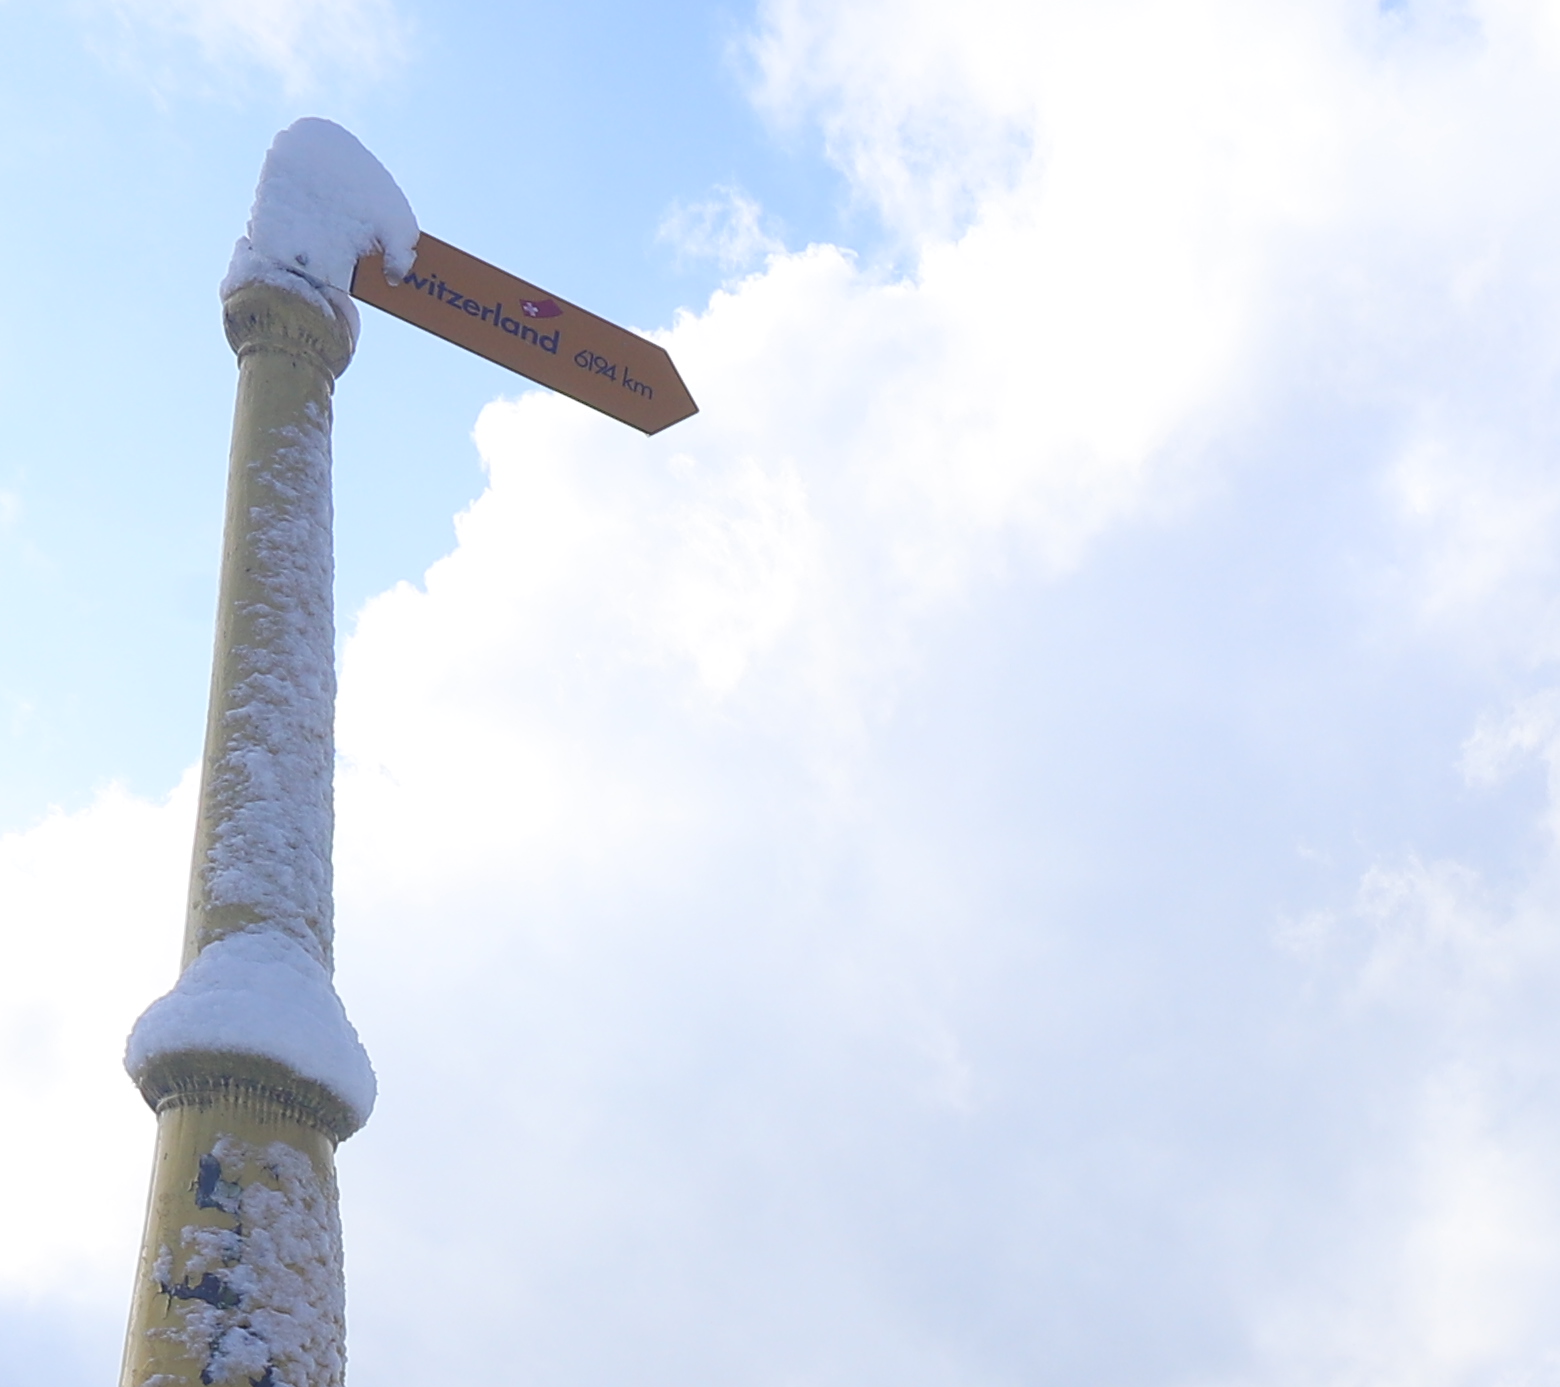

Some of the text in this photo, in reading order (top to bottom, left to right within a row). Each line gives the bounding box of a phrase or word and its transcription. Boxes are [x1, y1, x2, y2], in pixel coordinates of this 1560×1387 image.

[403, 270, 654, 400] witzerland 6194 km
